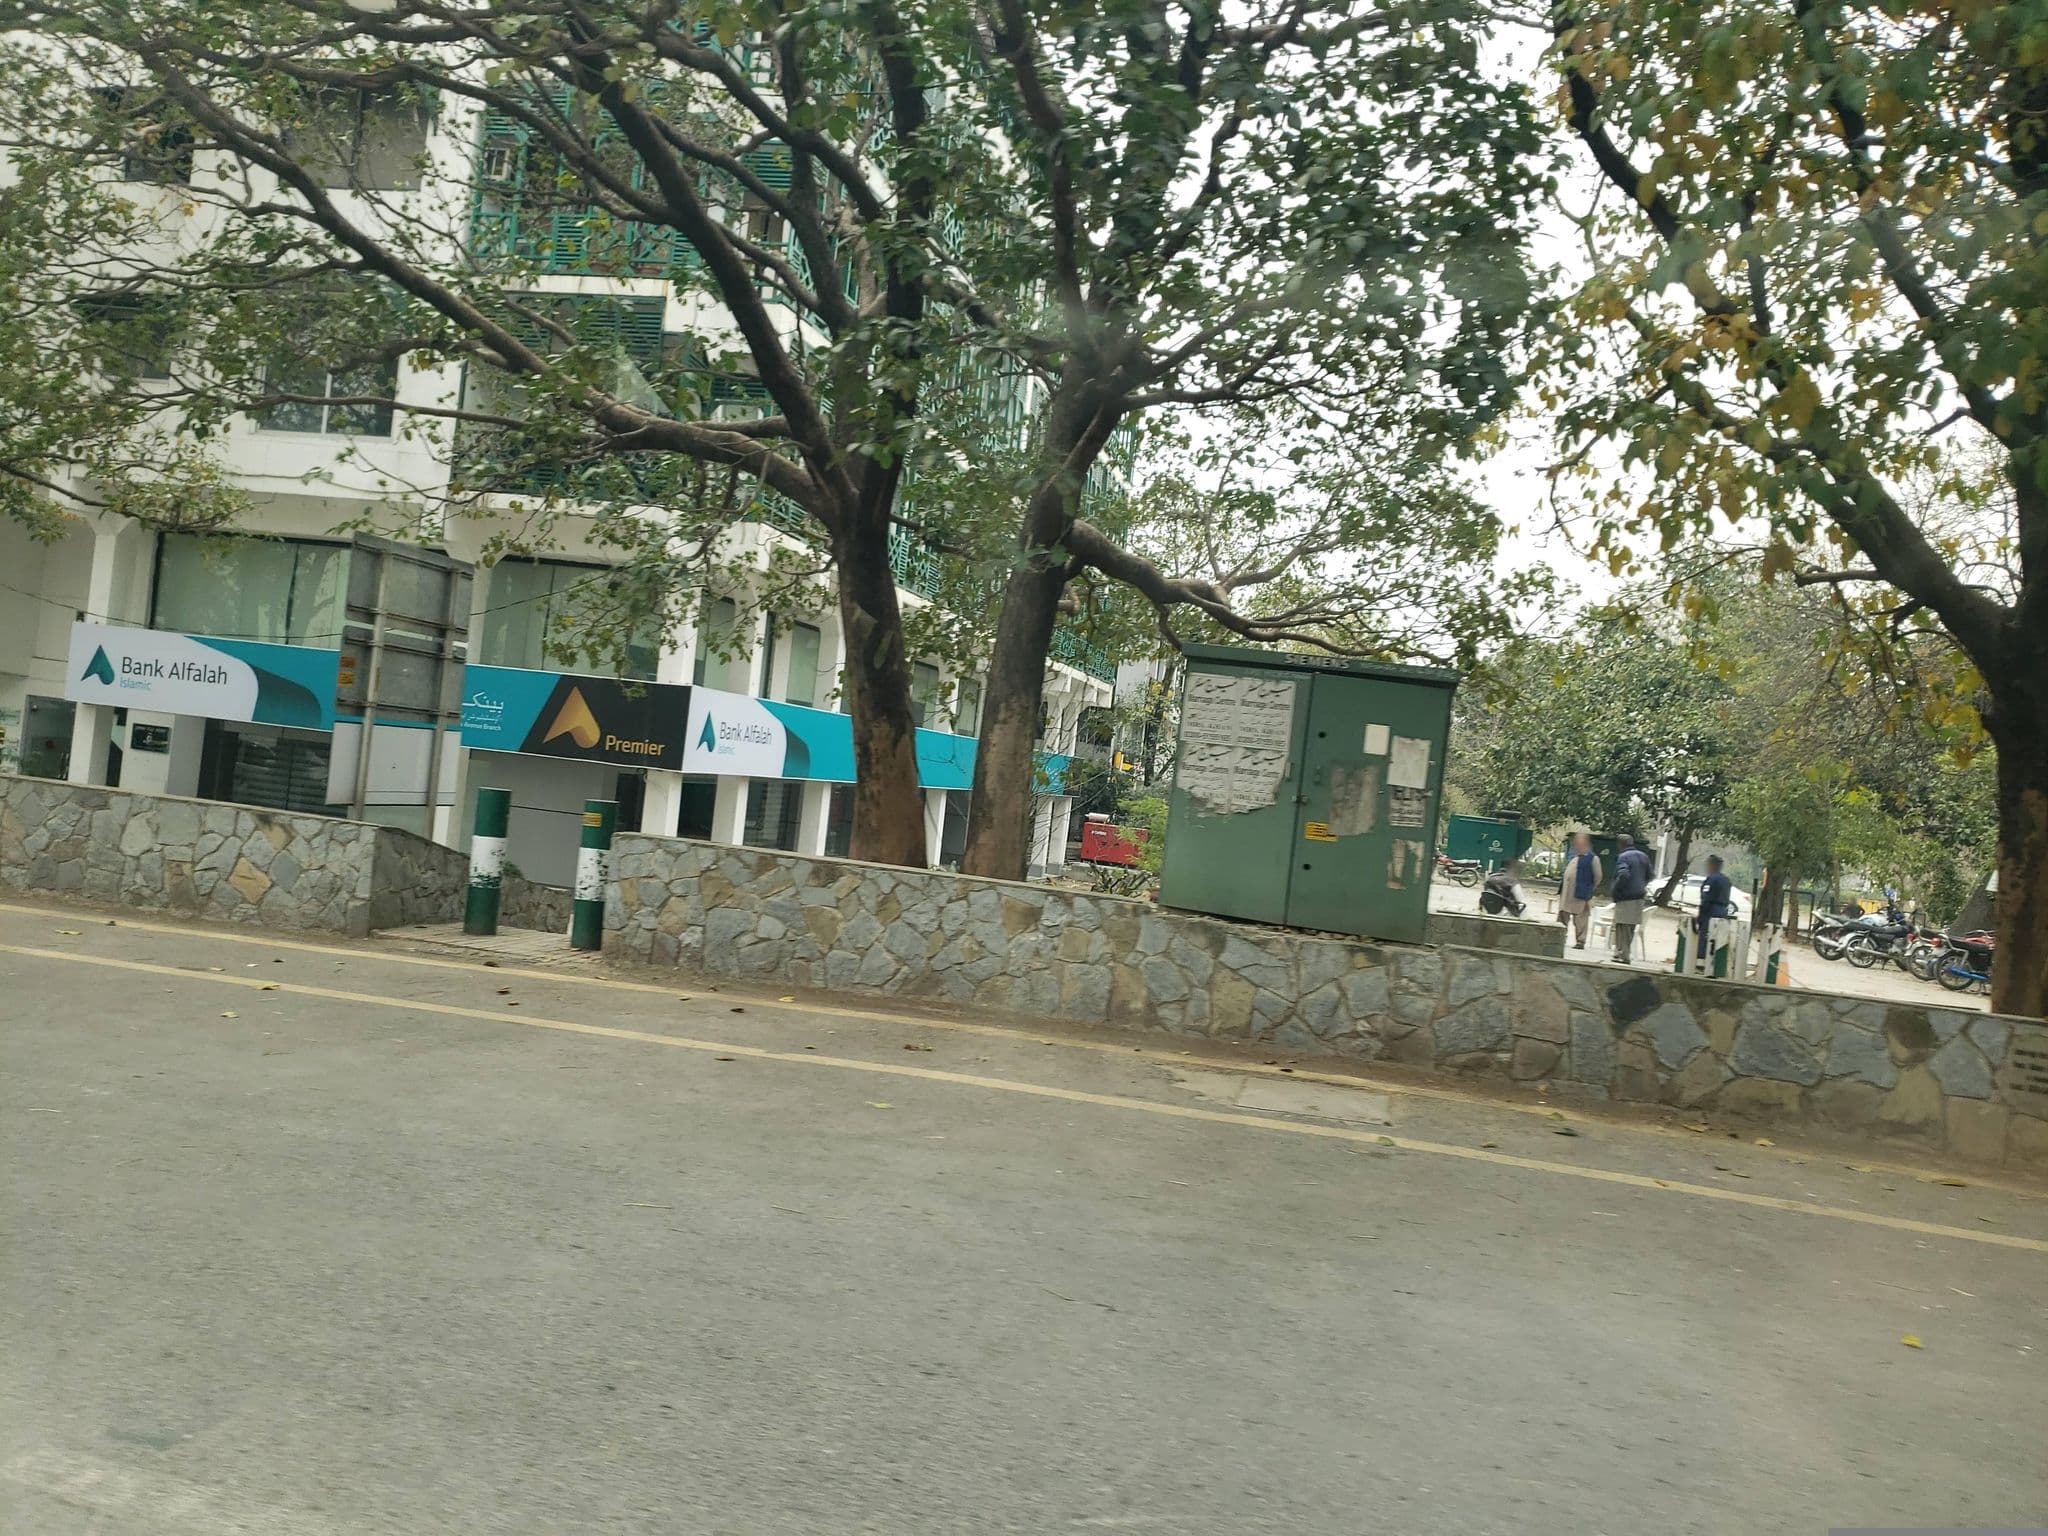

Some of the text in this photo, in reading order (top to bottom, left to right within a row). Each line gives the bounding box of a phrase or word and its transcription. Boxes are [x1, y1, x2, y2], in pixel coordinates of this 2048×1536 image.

[121, 656, 228, 685] Bank Alfalah
[604, 734, 666, 756] Premier
[719, 721, 773, 746] Bank Alfalah
